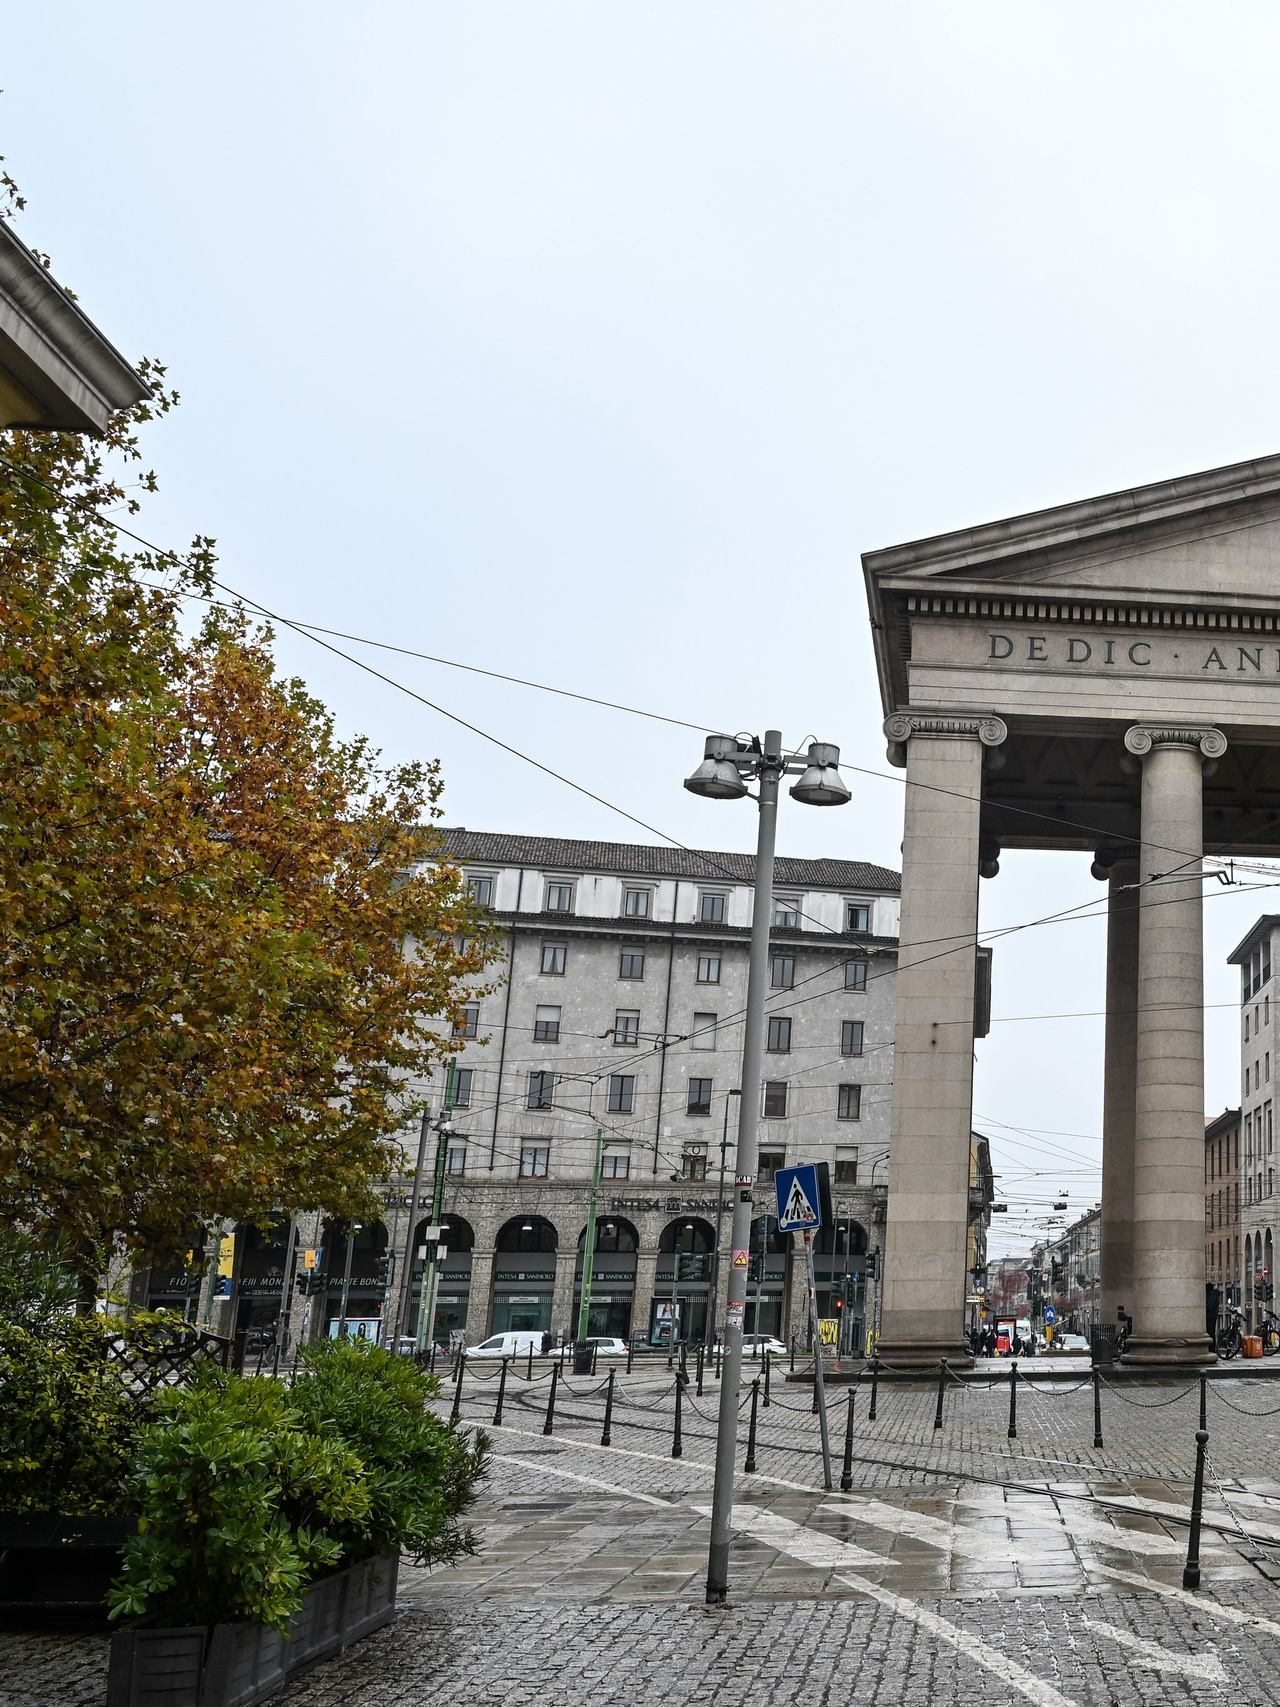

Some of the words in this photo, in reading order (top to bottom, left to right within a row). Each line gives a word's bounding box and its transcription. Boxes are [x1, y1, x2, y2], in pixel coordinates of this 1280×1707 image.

[988, 634, 1151, 666] DEDIC
[259, 1278, 293, 1286] MONA
[329, 1278, 358, 1286] PIATE
